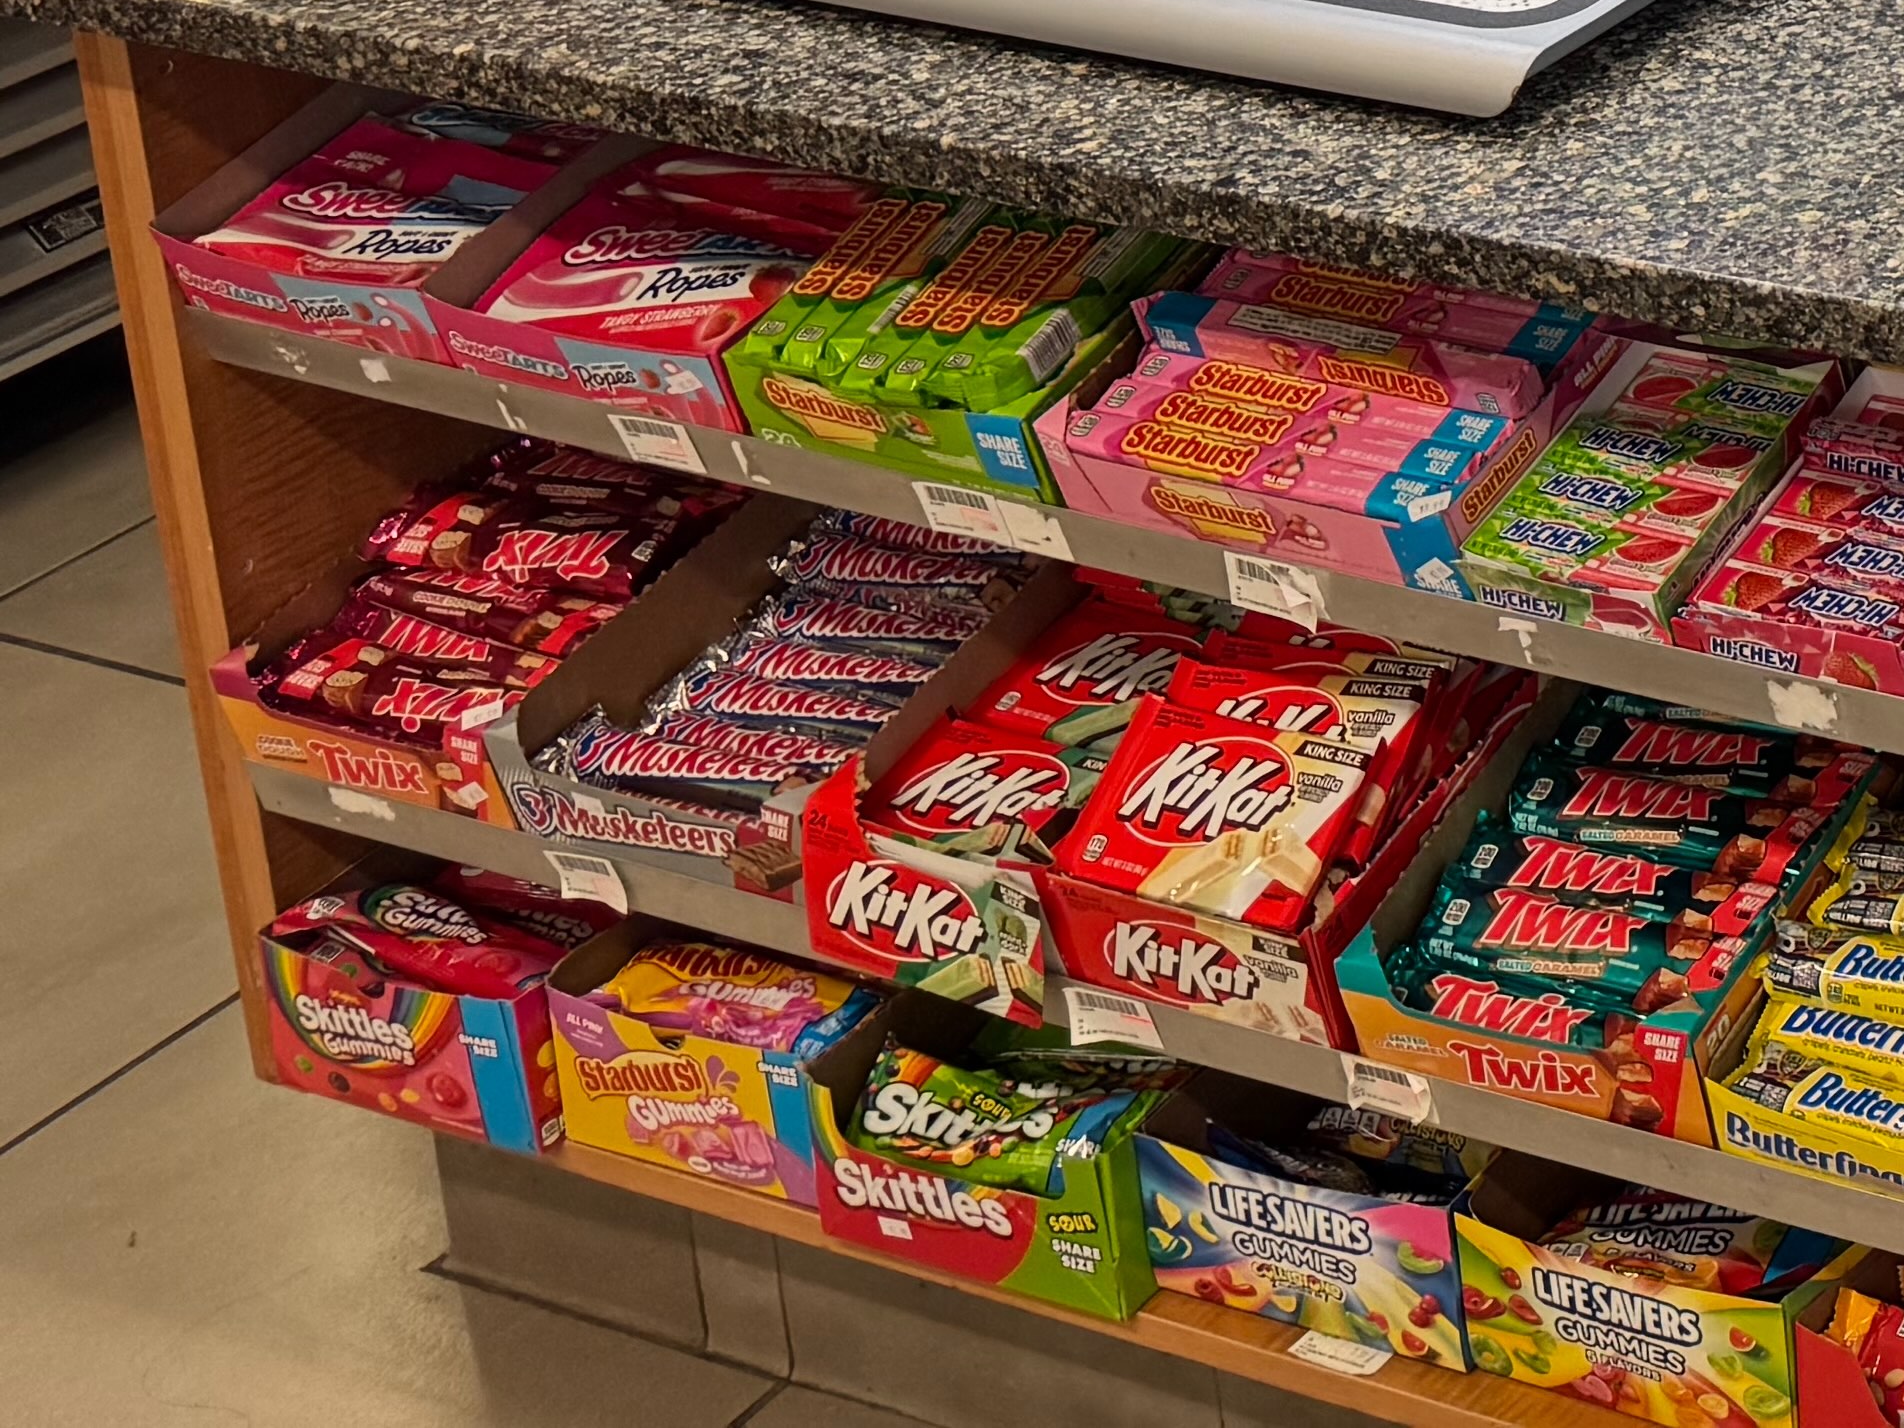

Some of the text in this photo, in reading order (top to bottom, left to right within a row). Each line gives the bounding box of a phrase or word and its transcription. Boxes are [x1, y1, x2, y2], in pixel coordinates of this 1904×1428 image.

[638, 267, 744, 301] Ropes
[896, 226, 1010, 330] Starburst
[981, 226, 1098, 328] Starburst
[295, 299, 349, 321] Ropes
[578, 365, 637, 390] Ropes
[1189, 361, 1327, 413] Starburst
[766, 377, 887, 433] Starburst
[977, 431, 1023, 454] SHARE
[996, 450, 1026, 471] SIZE
[1120, 424, 1260, 477] Starburst
[1152, 485, 1276, 535] Starburst
[1539, 473, 1641, 511] HI-CHEW
[1480, 585, 1564, 620] HI-CHEW
[1710, 637, 1798, 672] HI-CHEW
[1349, 683, 1412, 699] KING SIZE
[307, 740, 429, 794] Twix
[892, 752, 1067, 828] KitKat
[1117, 742, 1291, 836] KitKat
[1296, 772, 1343, 792] vanilla
[513, 781, 735, 856] 3 Musketeers
[829, 864, 985, 959] KitKat
[1481, 887, 1652, 952] Twix
[1112, 924, 1258, 1002] KitKat
[293, 995, 413, 1048] Skittles
[320, 1030, 415, 1066] Gummies
[1448, 1041, 1601, 1097] Twix
[577, 1055, 705, 1099] Starburst
[627, 1095, 740, 1126] Gummies
[834, 1157, 1014, 1238] Skittles
[1047, 1213, 1097, 1235] SOUR
[1051, 1239, 1102, 1261] SHARE
[1061, 1254, 1096, 1275] SIZE
[1231, 1233, 1358, 1286] GUMMIES
[1554, 1318, 1686, 1375] GUMMIES
